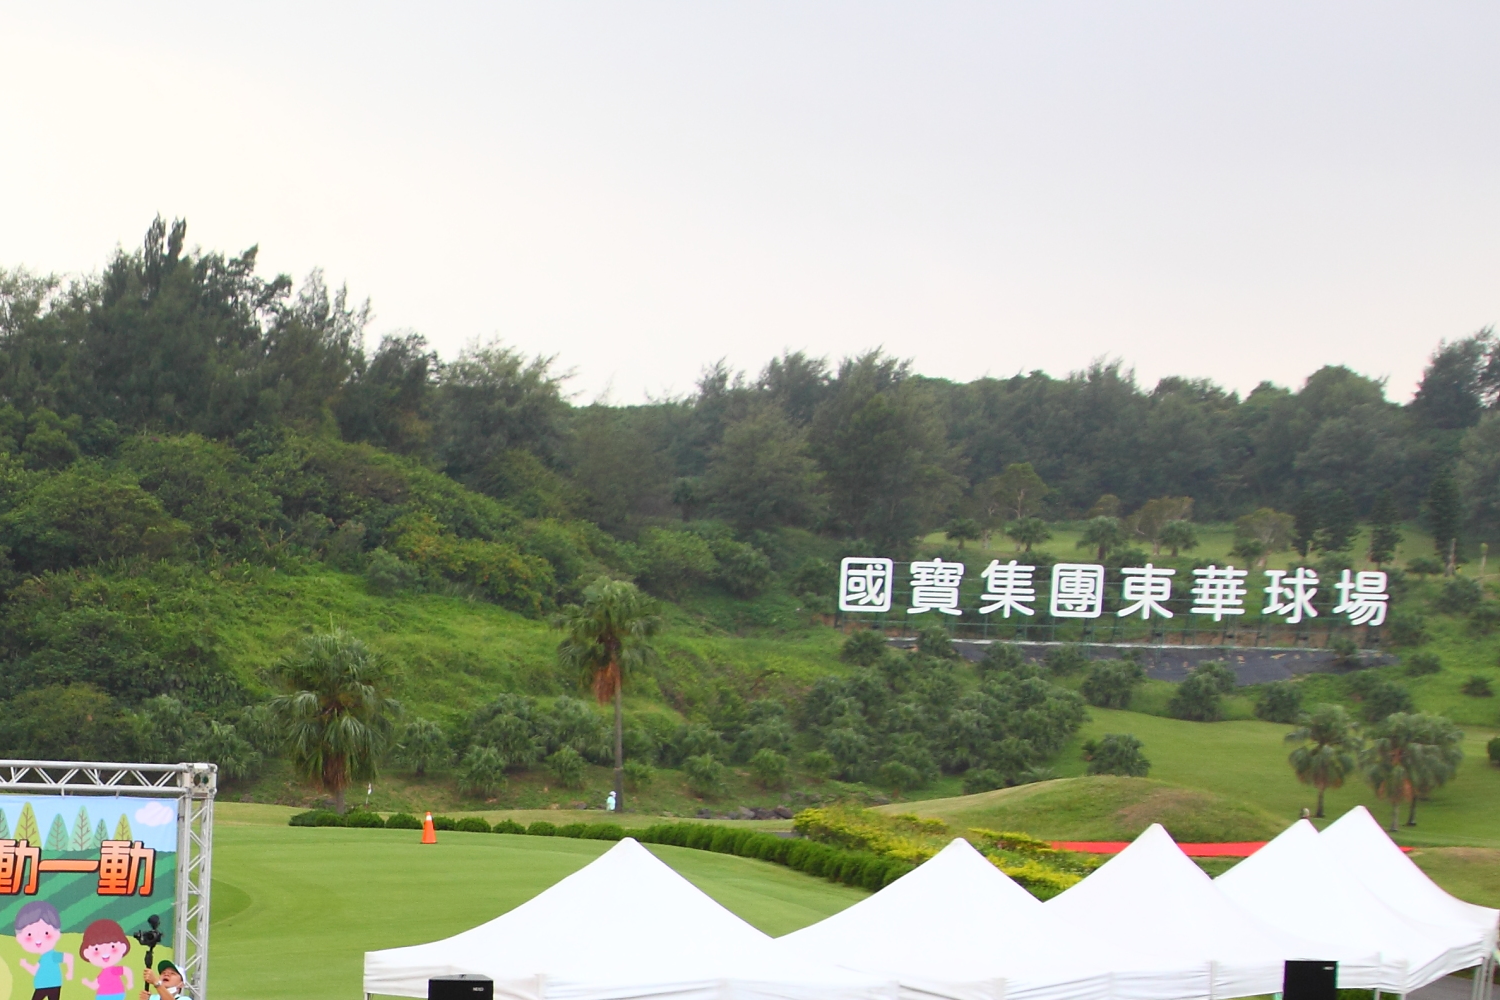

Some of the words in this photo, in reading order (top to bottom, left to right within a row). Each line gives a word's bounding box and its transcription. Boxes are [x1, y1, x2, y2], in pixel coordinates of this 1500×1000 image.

[838, 556, 1390, 627] 國寶集團東華球場
